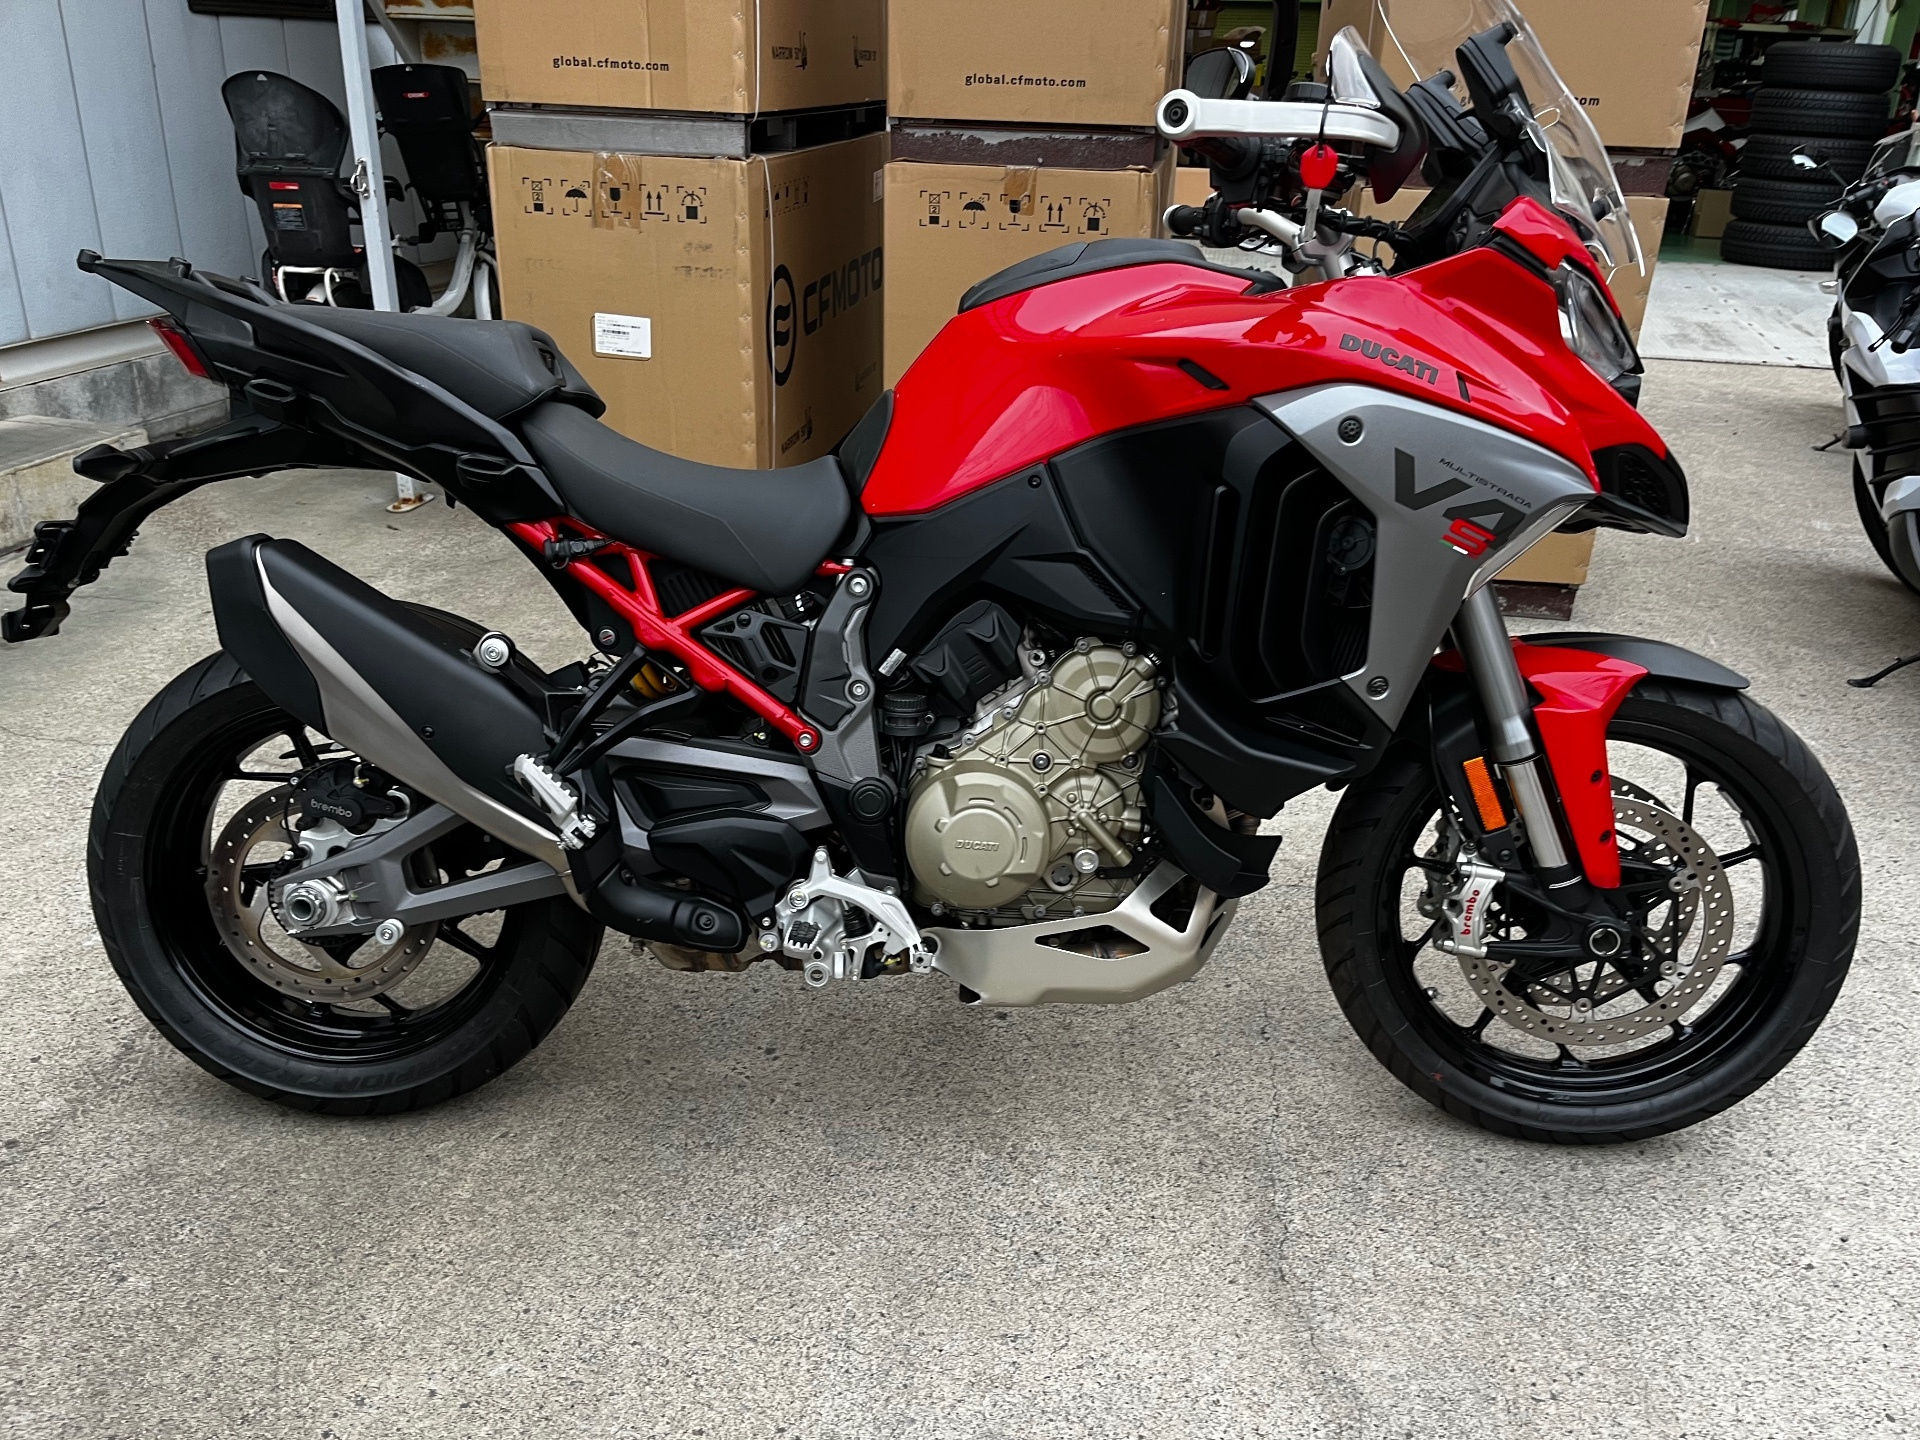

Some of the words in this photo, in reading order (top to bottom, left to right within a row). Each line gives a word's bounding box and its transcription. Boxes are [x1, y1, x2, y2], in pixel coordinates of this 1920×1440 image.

[553, 56, 669, 71] global.cfmoto.com
[965, 73, 1086, 87] global.cfmoto.com
[803, 246, 883, 336] CFMOTO
[1339, 333, 1439, 385] DUCATI
[1438, 457, 1533, 509] MULTISTRADA
[1442, 517, 1497, 558] S
[311, 799, 352, 818] brembo
[955, 840, 999, 851] DUCATI
[1460, 889, 1480, 936] brembo
